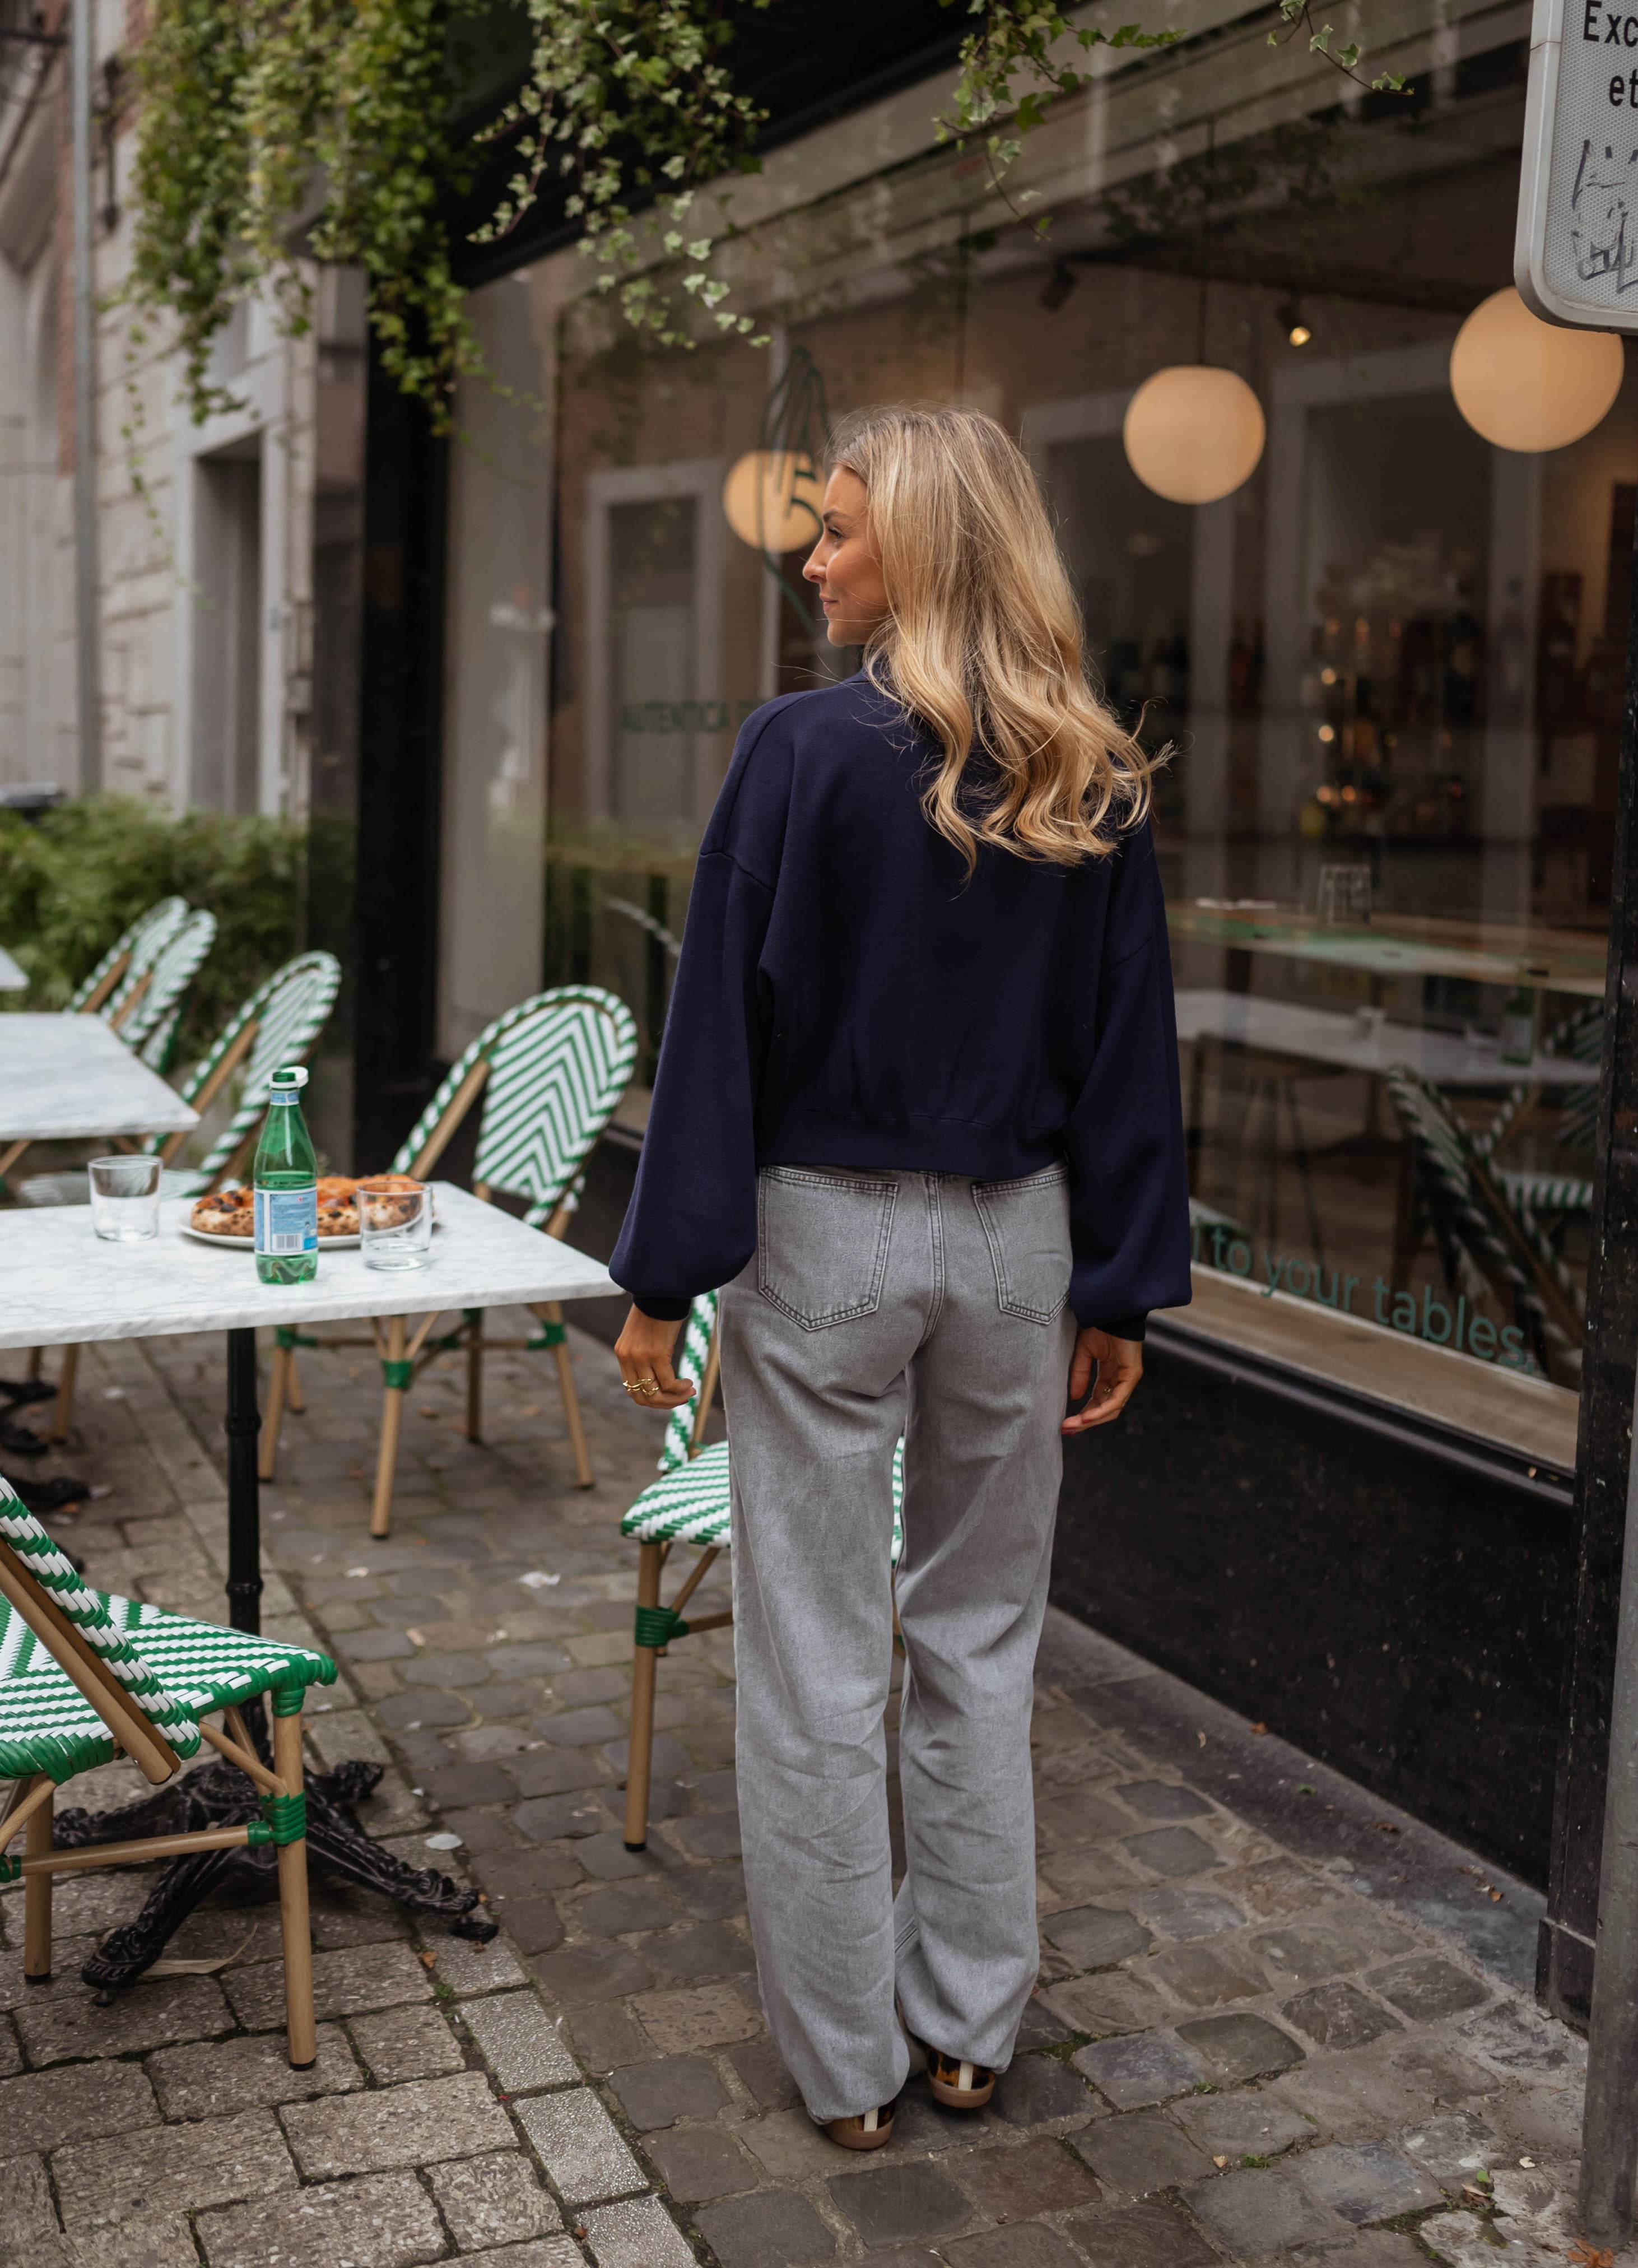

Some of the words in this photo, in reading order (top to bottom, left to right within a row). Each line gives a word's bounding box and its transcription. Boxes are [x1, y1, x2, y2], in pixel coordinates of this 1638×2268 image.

[1584, 0, 1638, 47] Exc
[1212, 1225, 1251, 1277] to
[1260, 1249, 1360, 1312] your
